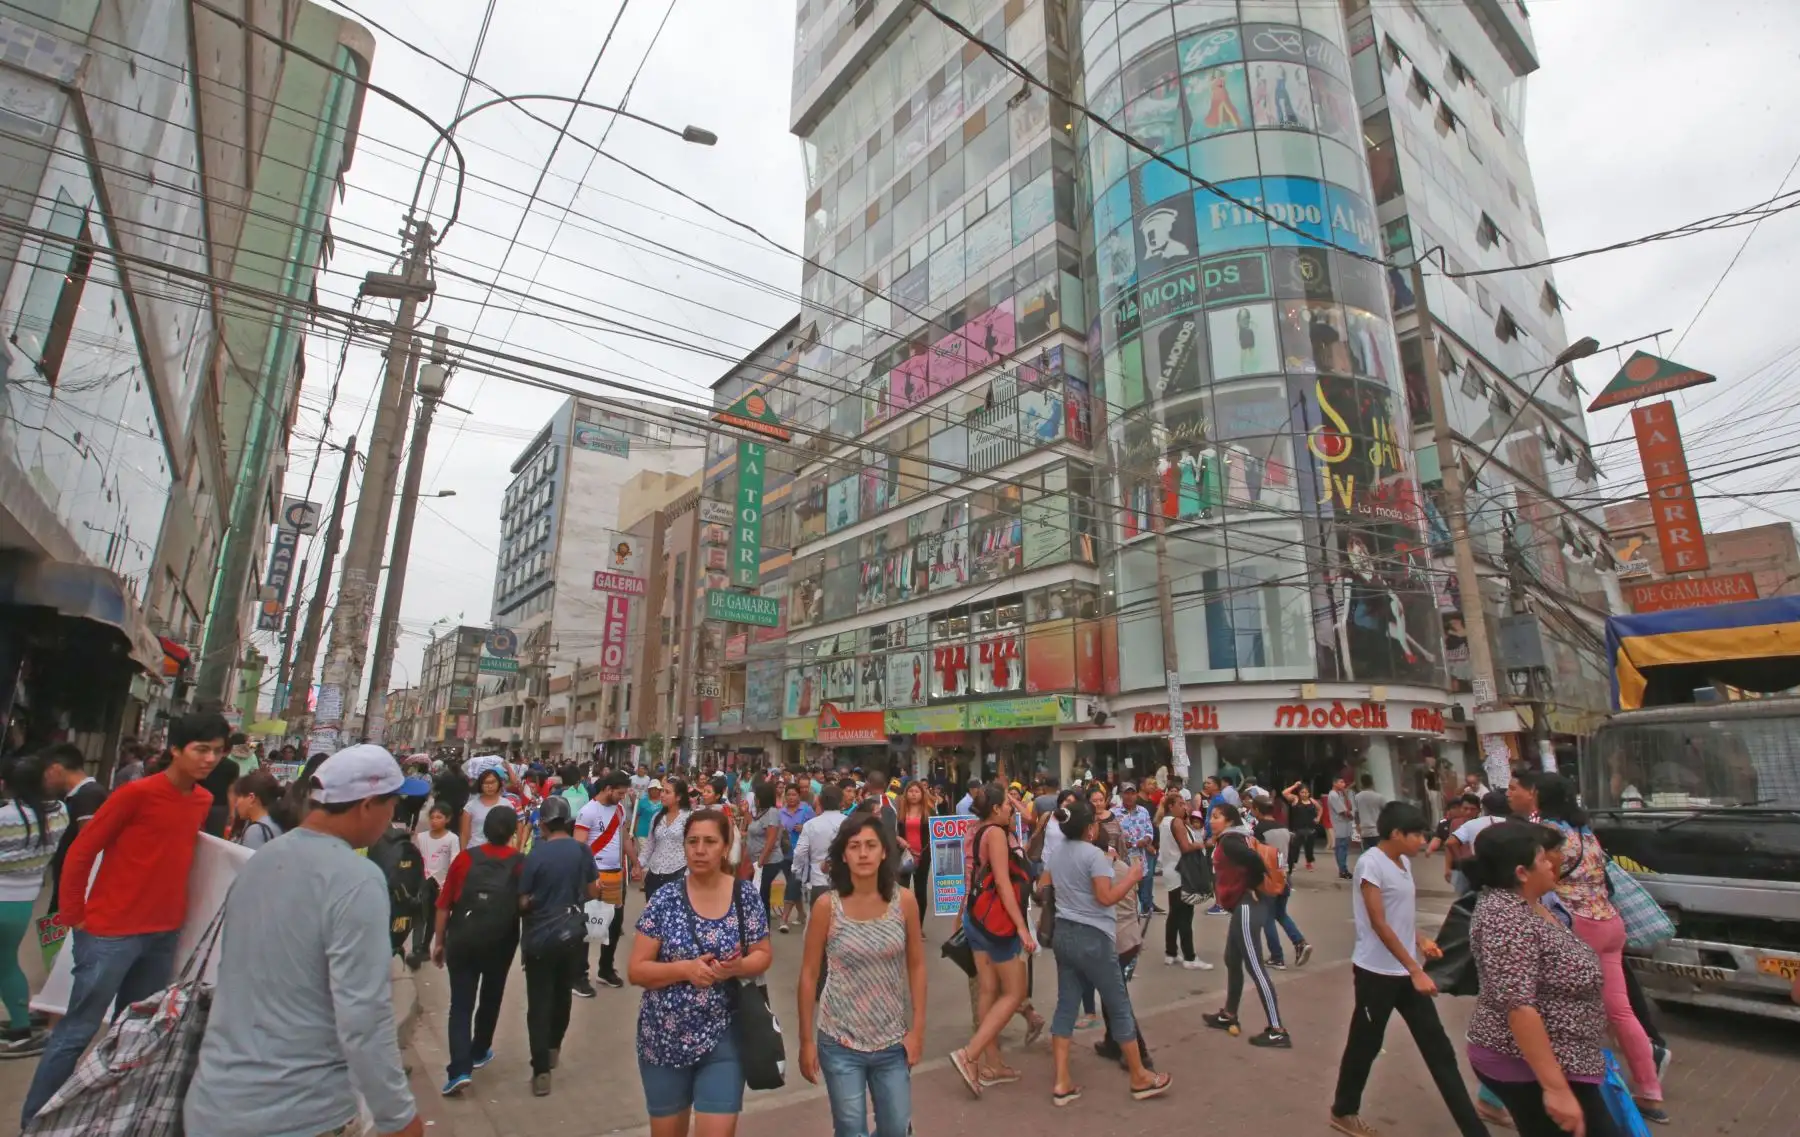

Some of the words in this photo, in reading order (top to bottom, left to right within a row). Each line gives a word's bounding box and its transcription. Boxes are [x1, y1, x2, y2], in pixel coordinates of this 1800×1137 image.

[1209, 196, 1322, 230] Filippo
[745, 442, 760, 475] LA
[1654, 461, 1697, 568] TORRE
[740, 488, 758, 584] TORRE
[262, 533, 296, 627] CARRON
[595, 573, 644, 593] GALERIA
[1635, 587, 1658, 604] DE
[1660, 578, 1750, 601] GAMARRA
[711, 591, 725, 608] DE
[727, 594, 777, 616] GAMARRA
[605, 598, 624, 667] LEO
[588, 917, 604, 925] OR
